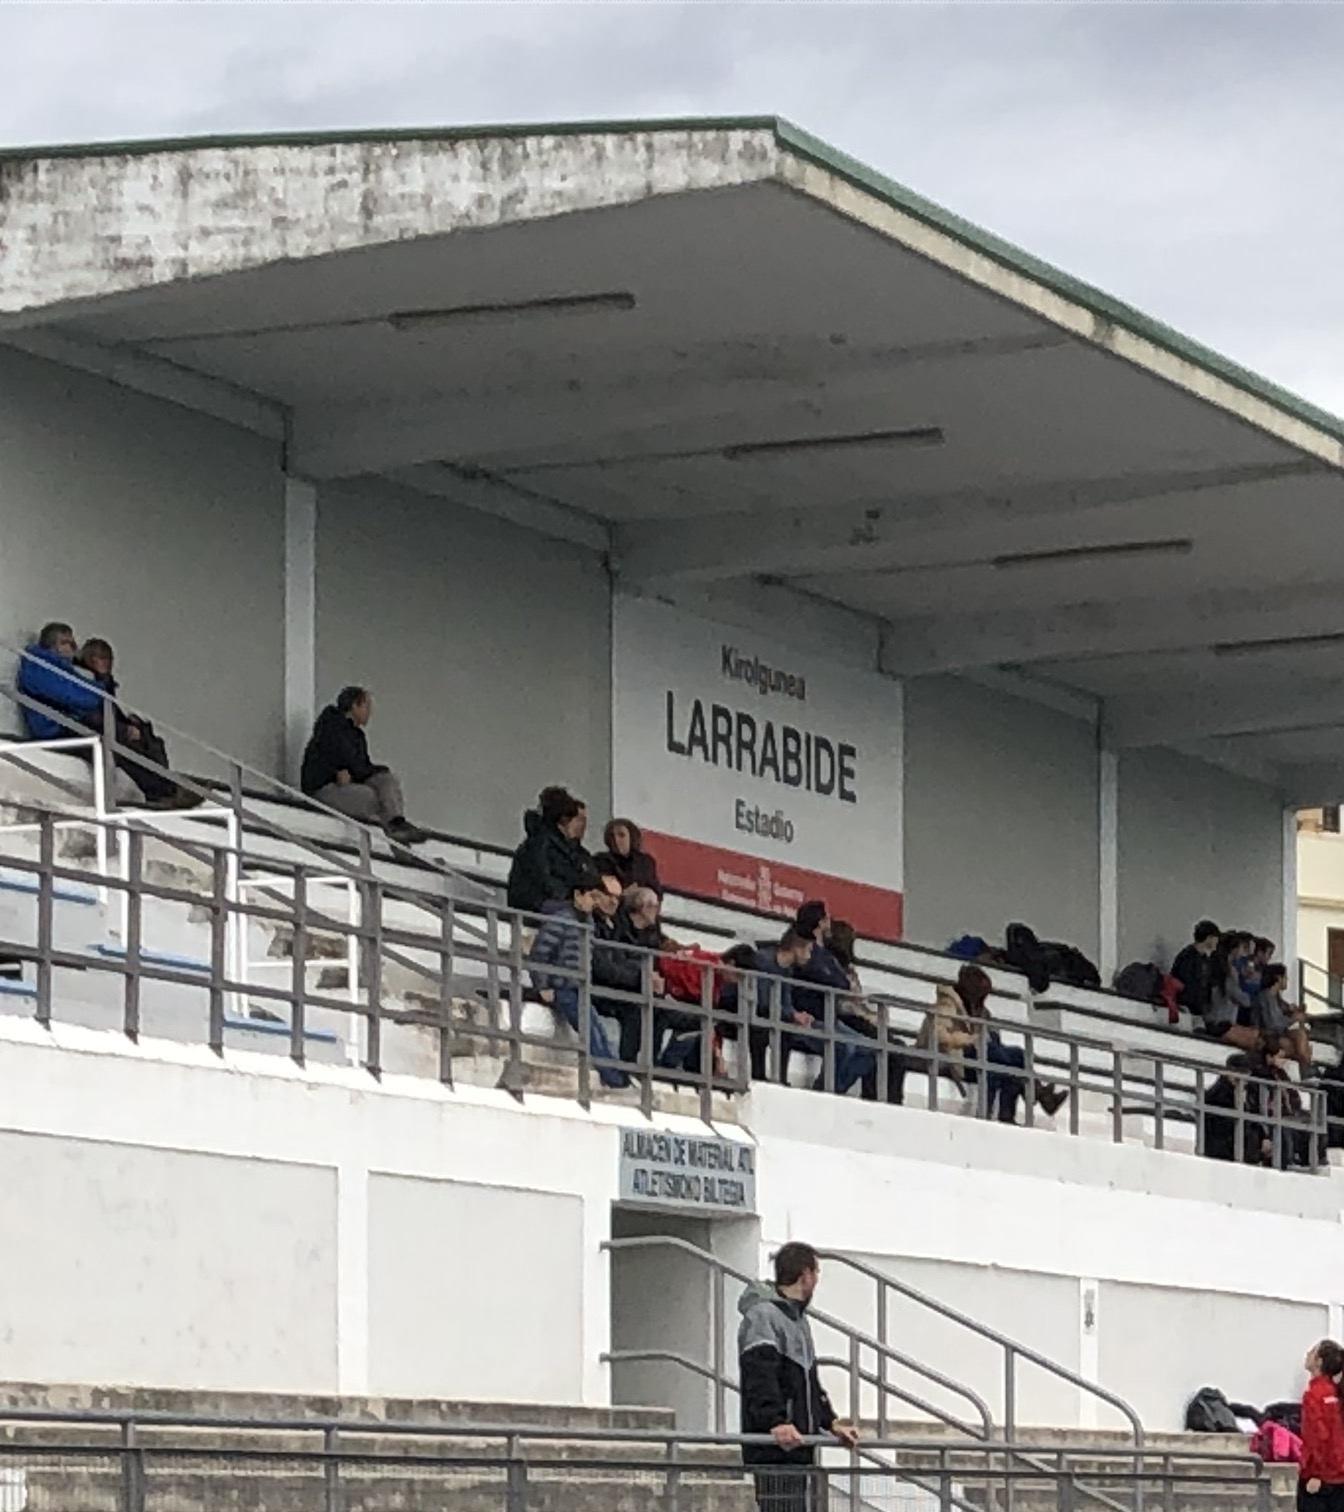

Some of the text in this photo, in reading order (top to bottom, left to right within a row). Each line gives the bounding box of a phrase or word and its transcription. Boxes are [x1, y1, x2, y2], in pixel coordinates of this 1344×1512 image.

[721, 645, 806, 701] Kirolgunea
[666, 689, 857, 803] LARRABIDE
[735, 798, 794, 844] Estadio
